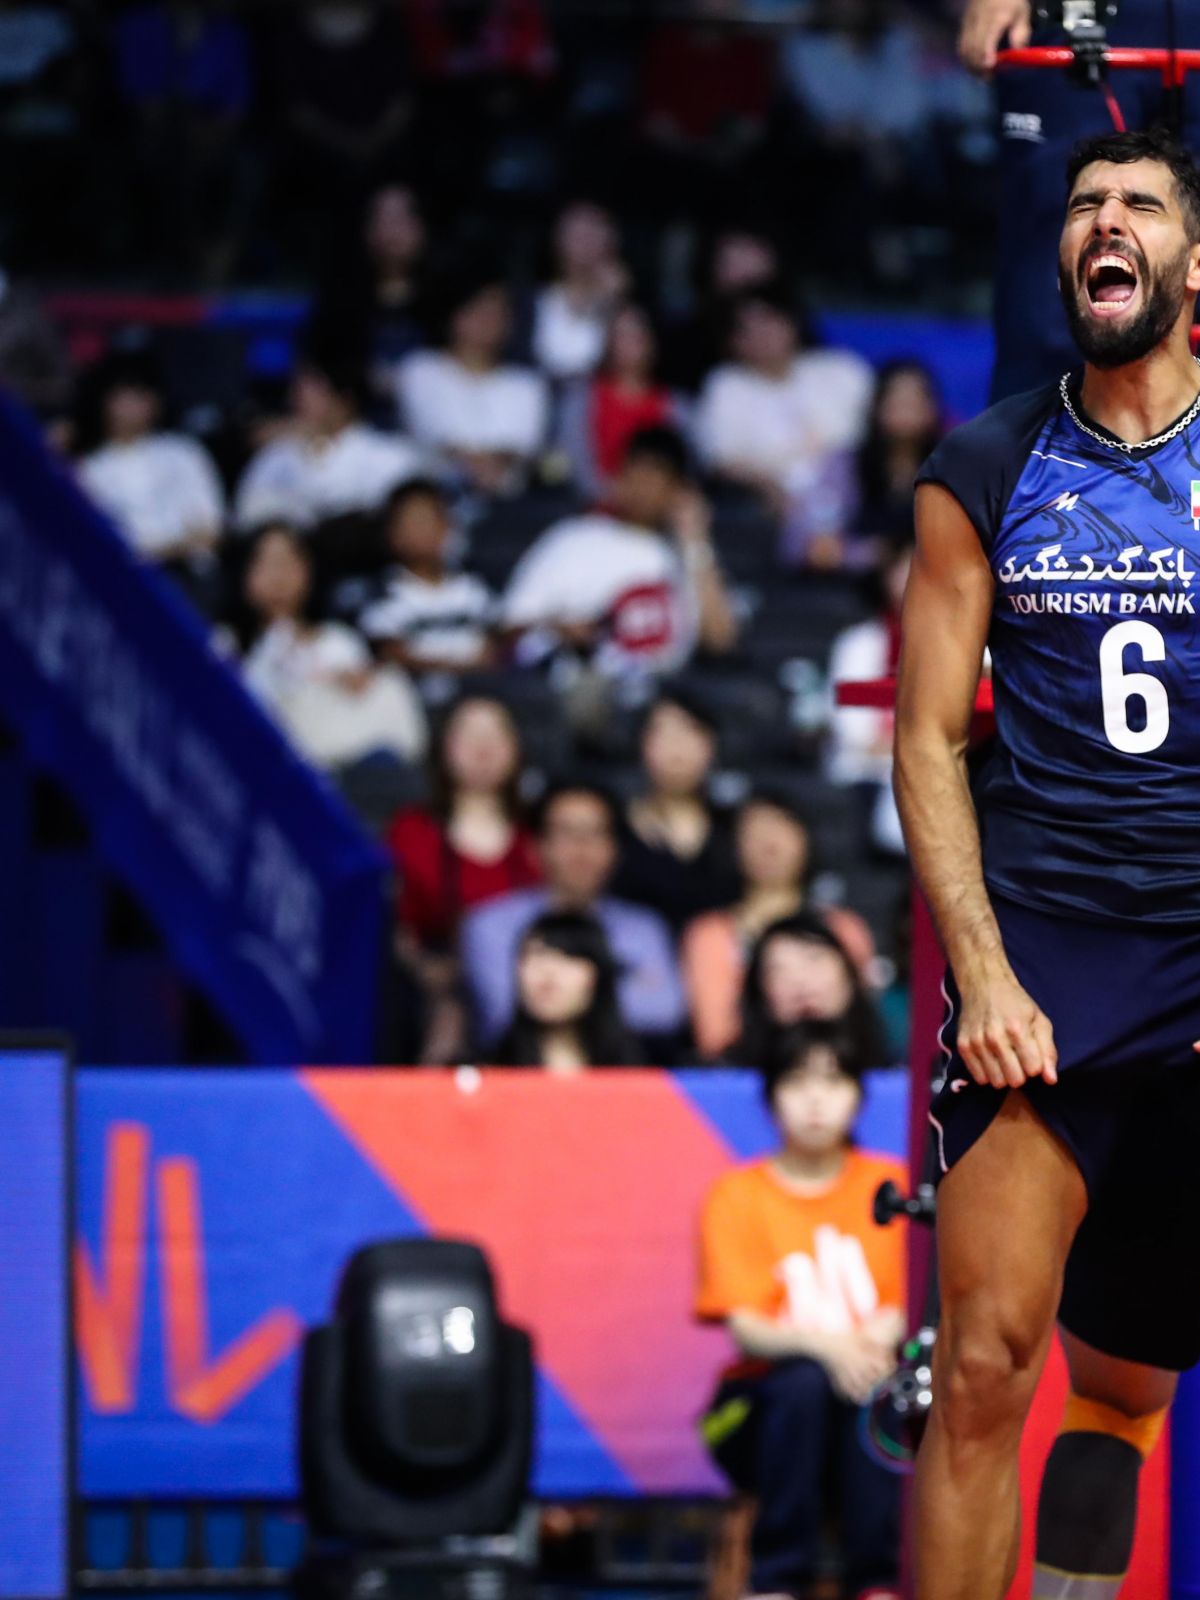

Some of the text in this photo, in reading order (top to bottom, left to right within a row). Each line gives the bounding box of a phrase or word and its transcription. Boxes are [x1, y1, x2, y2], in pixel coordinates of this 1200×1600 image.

[998, 543, 1196, 588] بانک گردشگری
[1010, 592, 1196, 614] TOURISM BANK
[1099, 619, 1170, 754] 6
